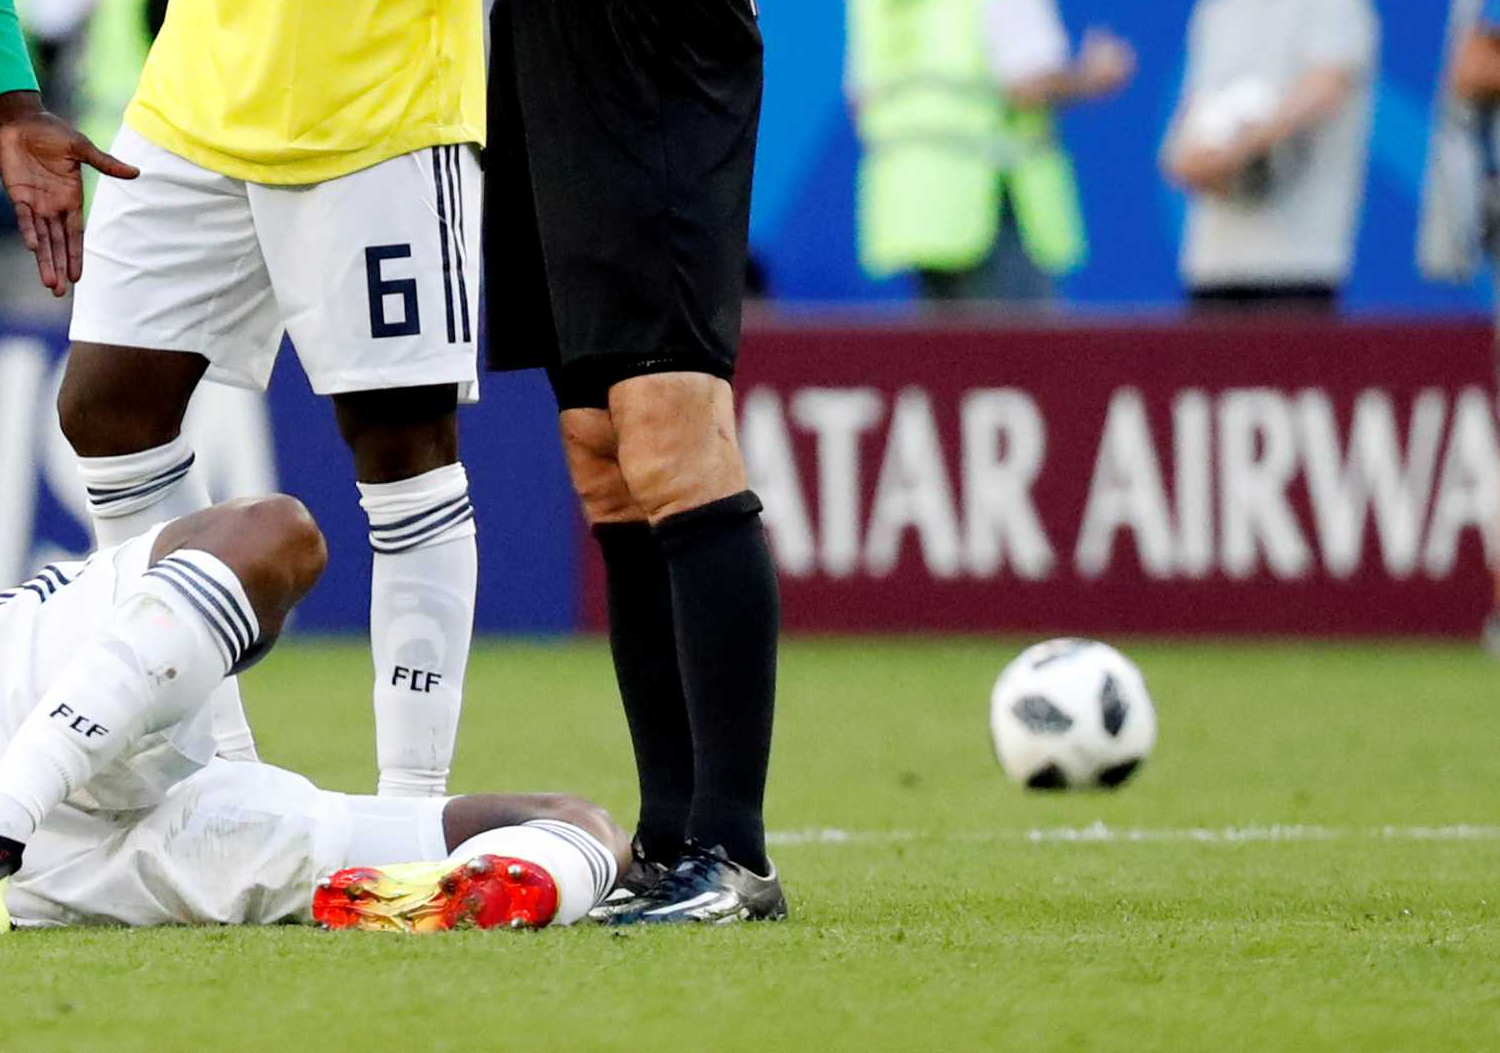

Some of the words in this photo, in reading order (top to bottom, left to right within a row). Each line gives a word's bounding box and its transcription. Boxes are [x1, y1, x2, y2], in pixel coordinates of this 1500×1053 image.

[365, 243, 421, 338] 6
[392, 666, 442, 693] FCF
[49, 703, 108, 737] FCF
